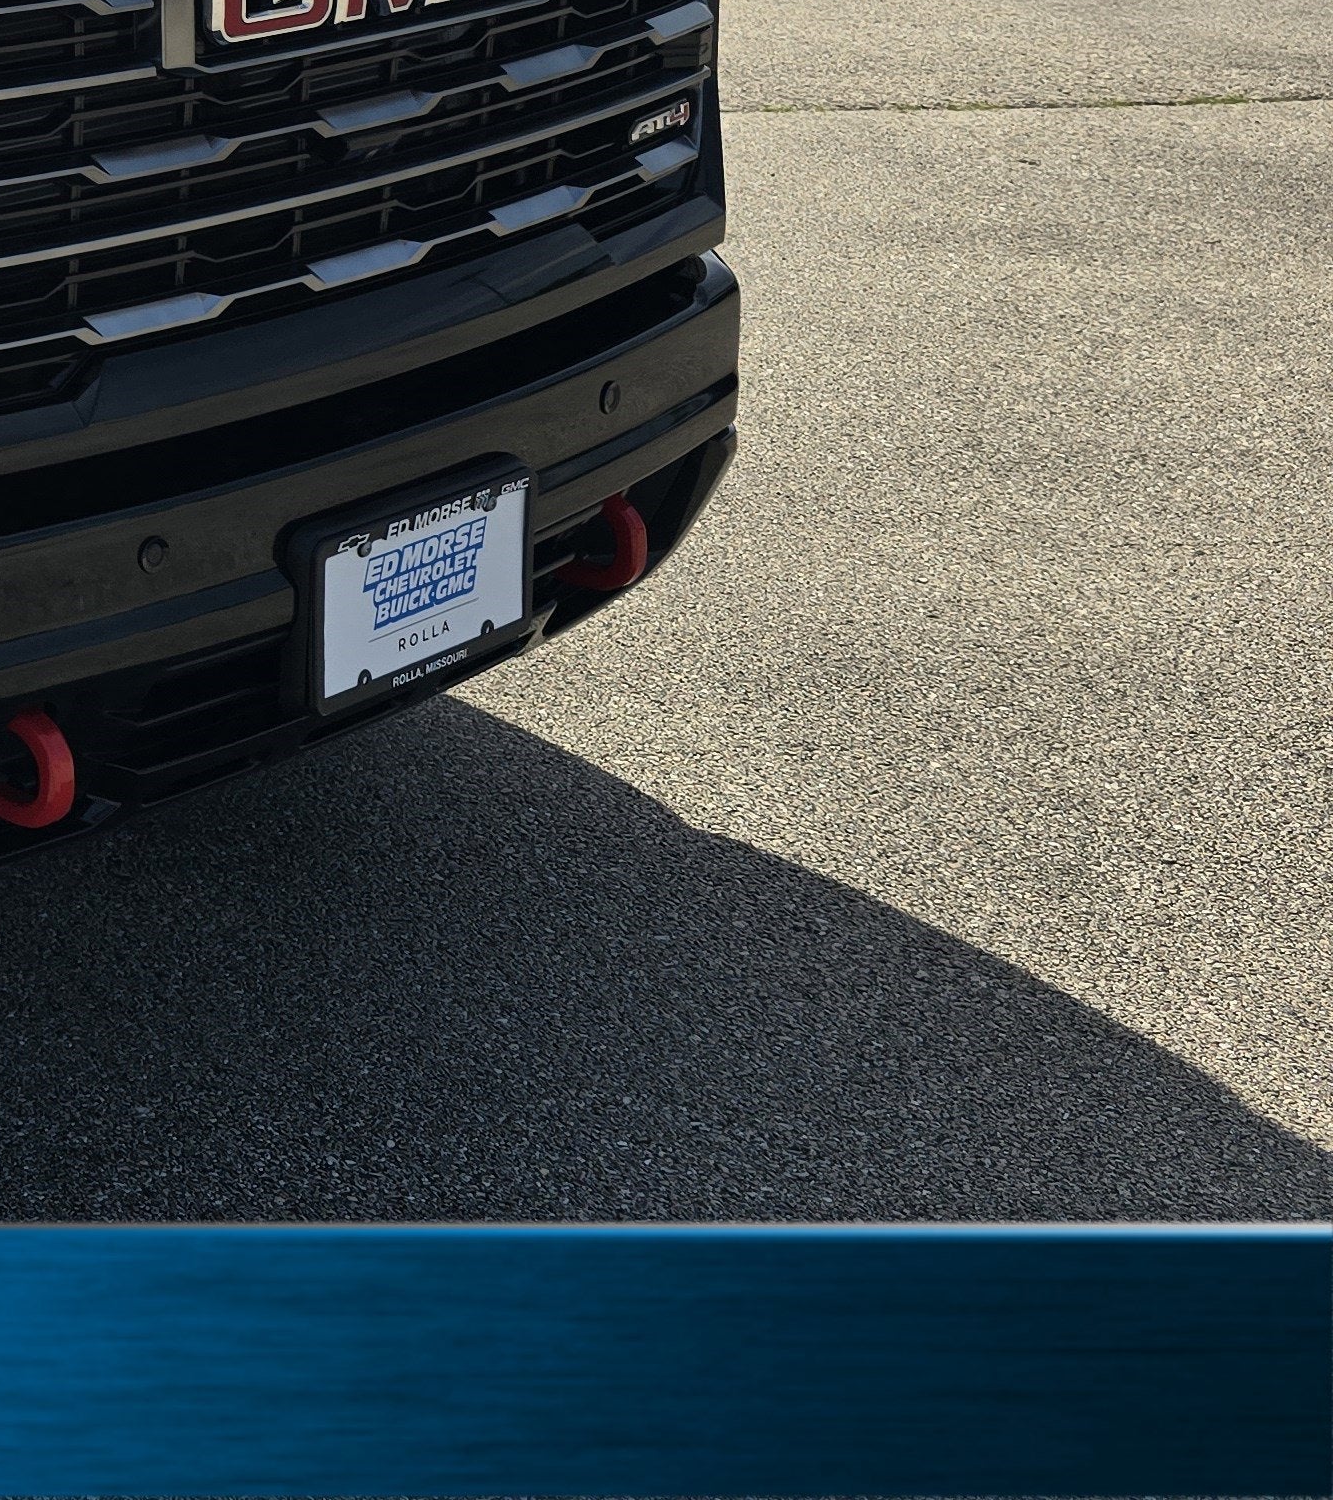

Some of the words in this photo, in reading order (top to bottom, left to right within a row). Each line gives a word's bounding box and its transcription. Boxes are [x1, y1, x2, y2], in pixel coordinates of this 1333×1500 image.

[631, 101, 690, 141] AT4
[387, 519, 410, 540] ED
[414, 495, 472, 531] MORSE
[501, 477, 530, 494] GMC
[365, 551, 400, 586] ED
[400, 518, 486, 573] MORSE
[374, 548, 477, 603] CHEVROLET
[398, 619, 450, 652] ROLLA
[392, 667, 424, 688] ROLLA,
[425, 649, 468, 675] MISSOURI
